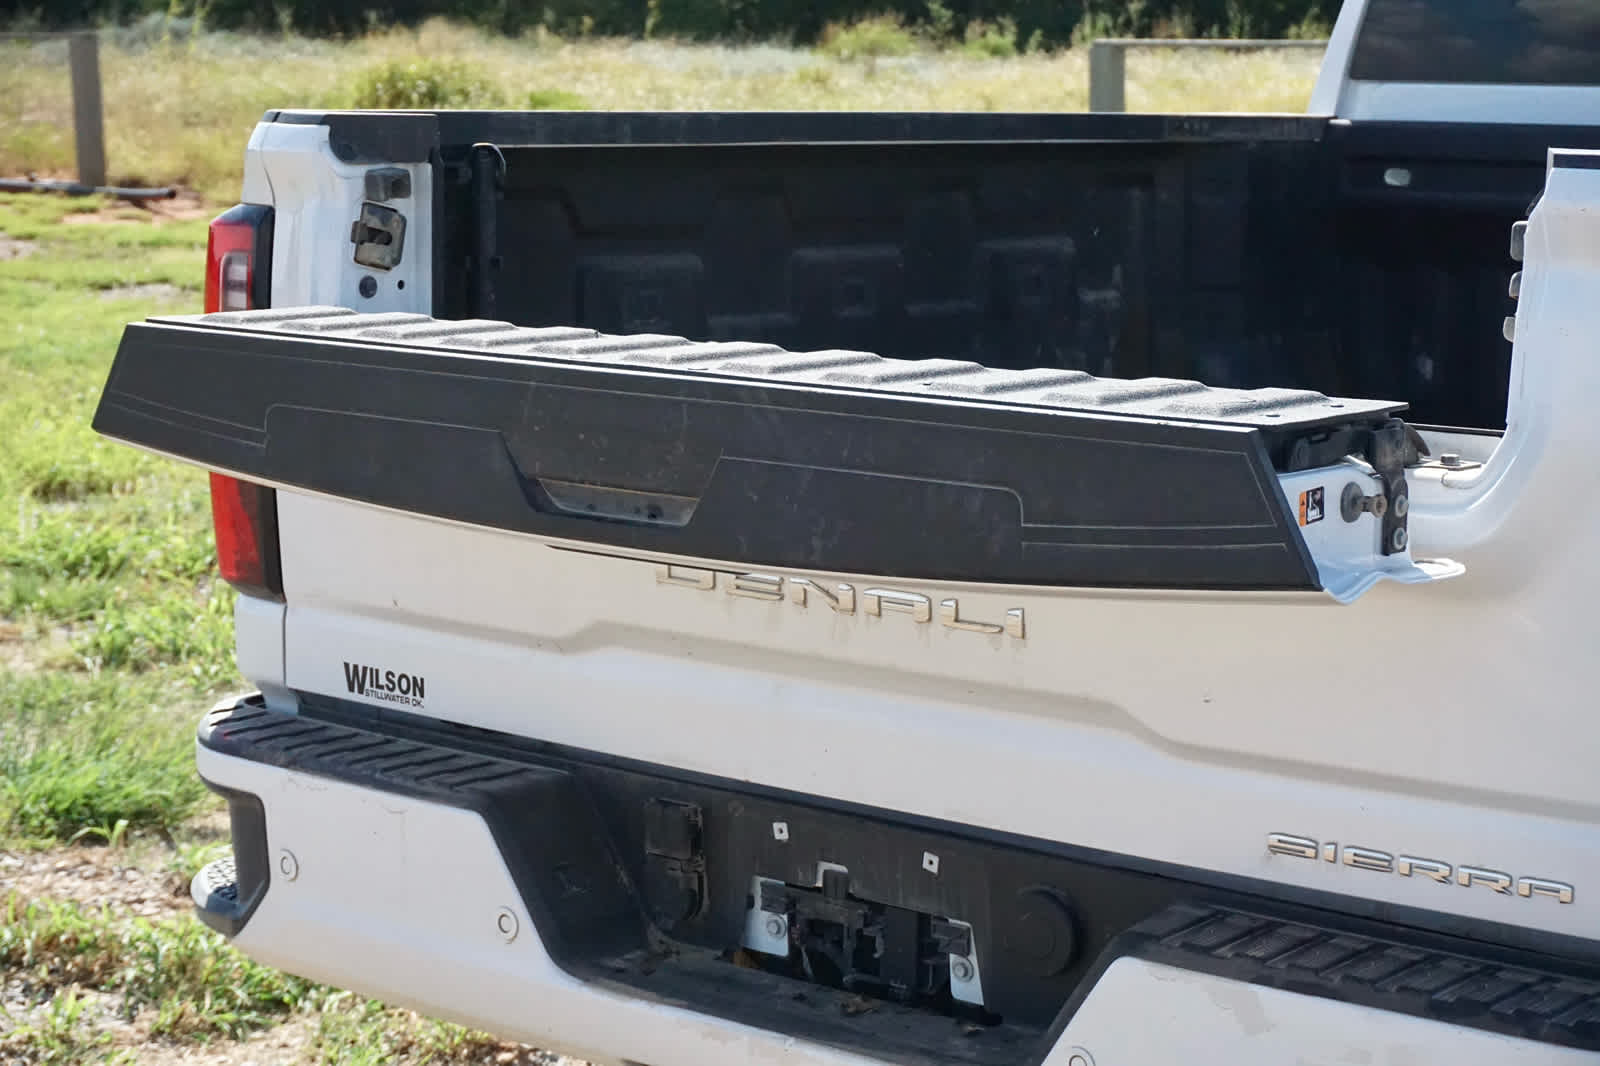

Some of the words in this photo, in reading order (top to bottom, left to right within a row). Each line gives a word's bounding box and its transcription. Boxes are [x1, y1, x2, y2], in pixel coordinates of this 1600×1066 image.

[344, 662, 425, 699] WILSON
[365, 689, 411, 705] STILLWATER
[1267, 832, 1574, 904] SIERRA
